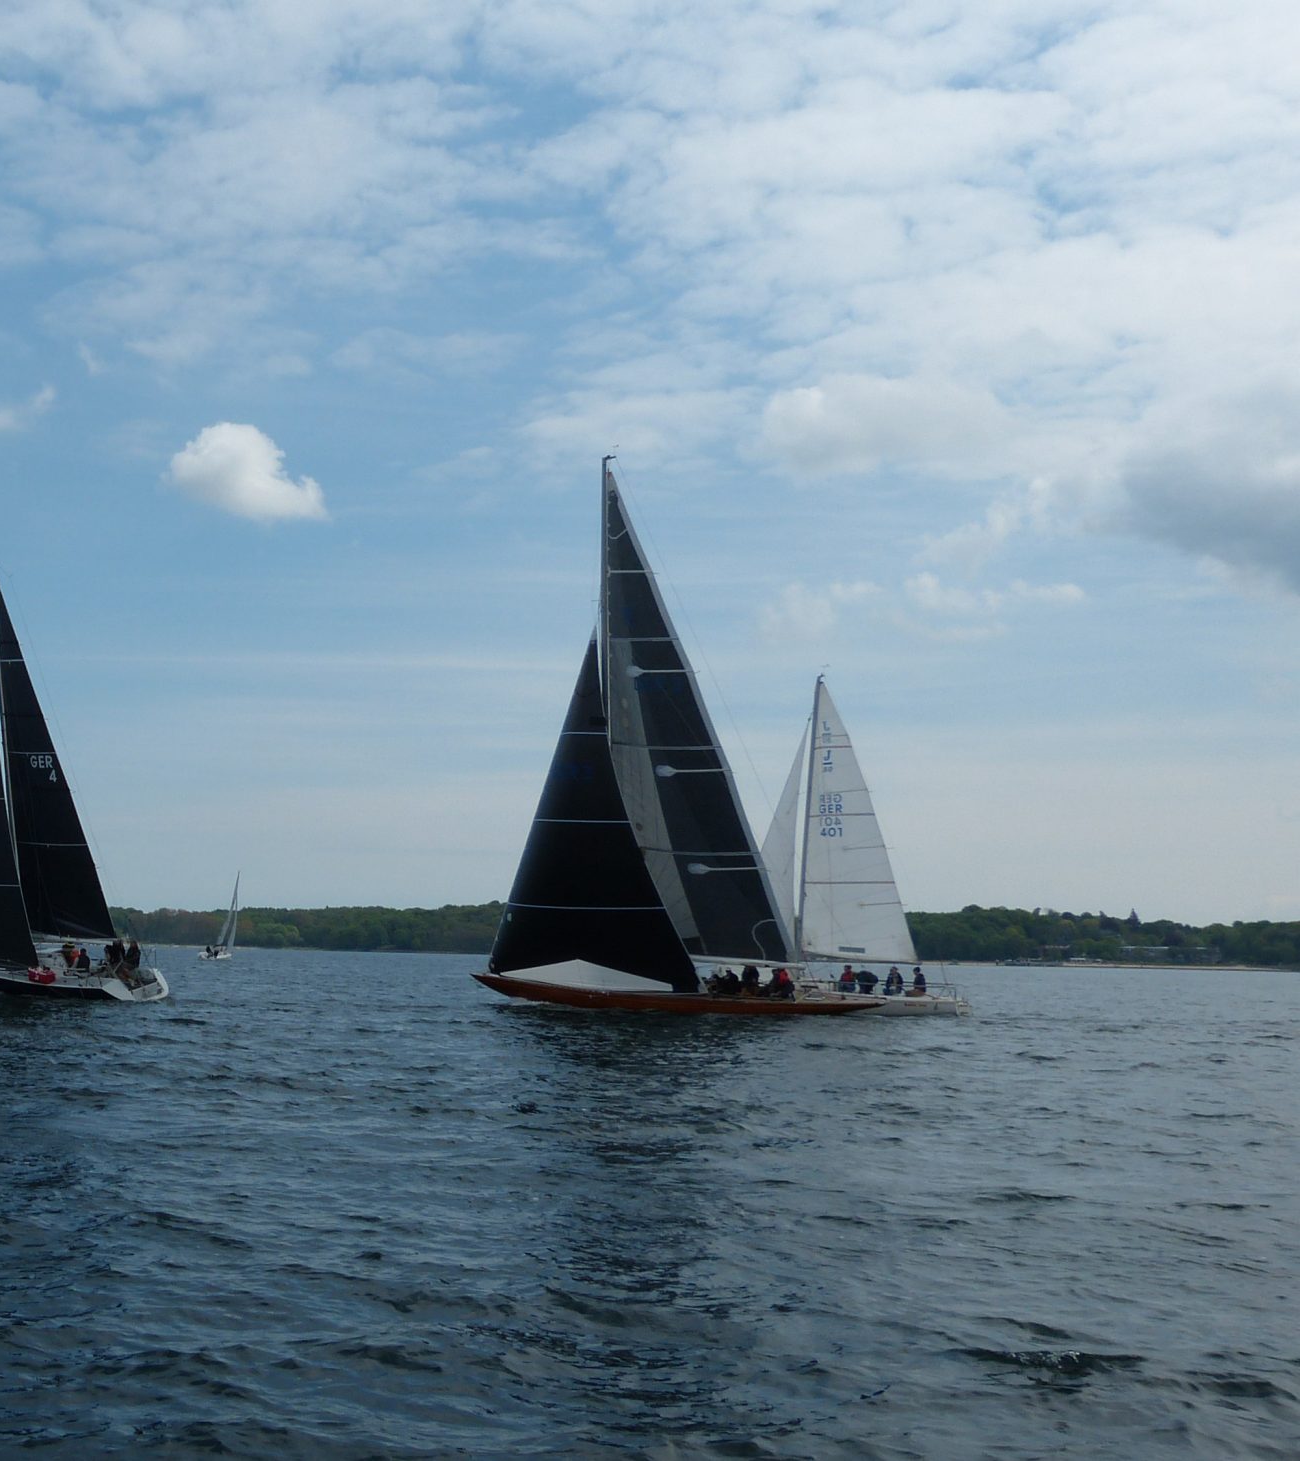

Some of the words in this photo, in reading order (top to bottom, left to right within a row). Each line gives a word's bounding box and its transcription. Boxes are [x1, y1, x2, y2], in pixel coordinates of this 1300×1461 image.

[30, 755, 54, 769] GER
[49, 769, 57, 782] 4
[820, 804, 843, 814] GER
[820, 827, 843, 837] 401
